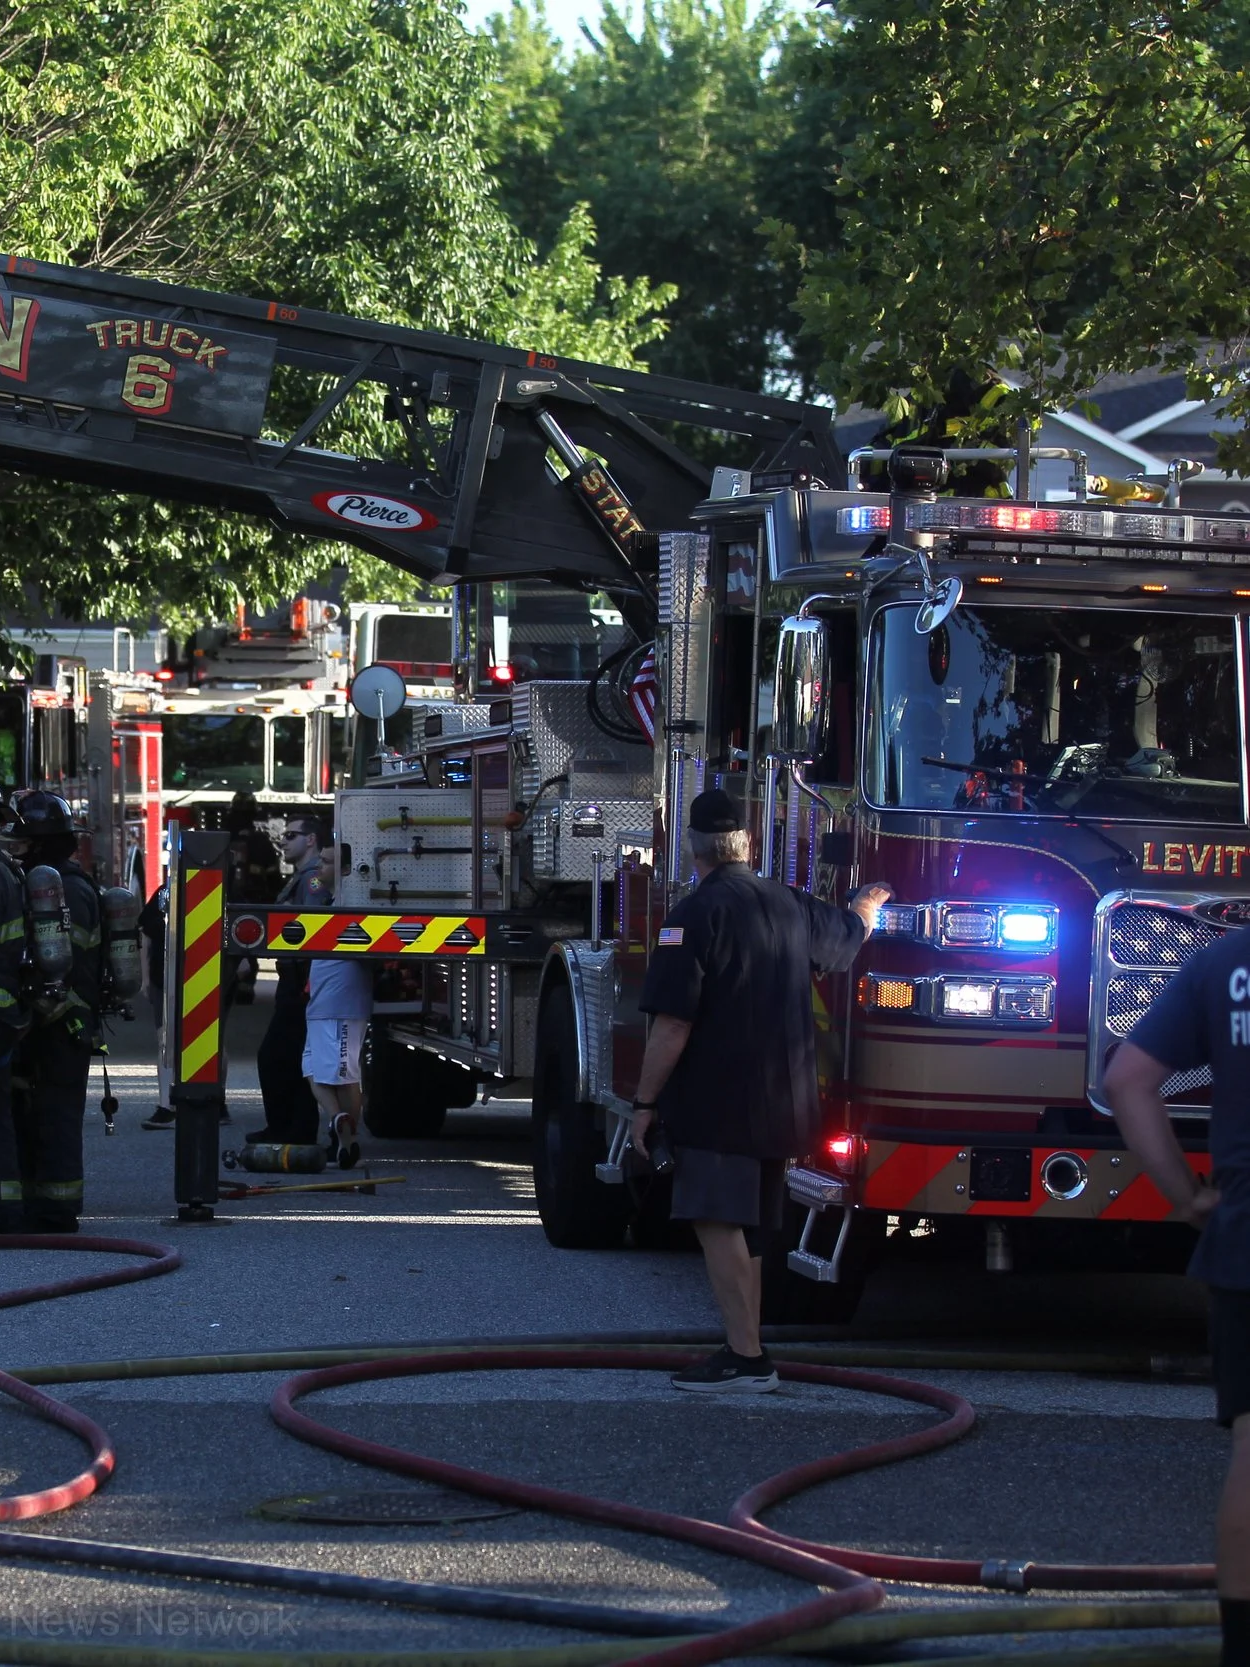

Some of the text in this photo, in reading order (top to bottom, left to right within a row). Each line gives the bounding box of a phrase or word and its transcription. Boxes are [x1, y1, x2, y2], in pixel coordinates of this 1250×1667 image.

[280, 308, 297, 320] 60
[86, 319, 227, 373] TRUCK
[539, 357, 557, 370] 50
[120, 354, 176, 416] 6
[337, 495, 410, 525] Pierce
